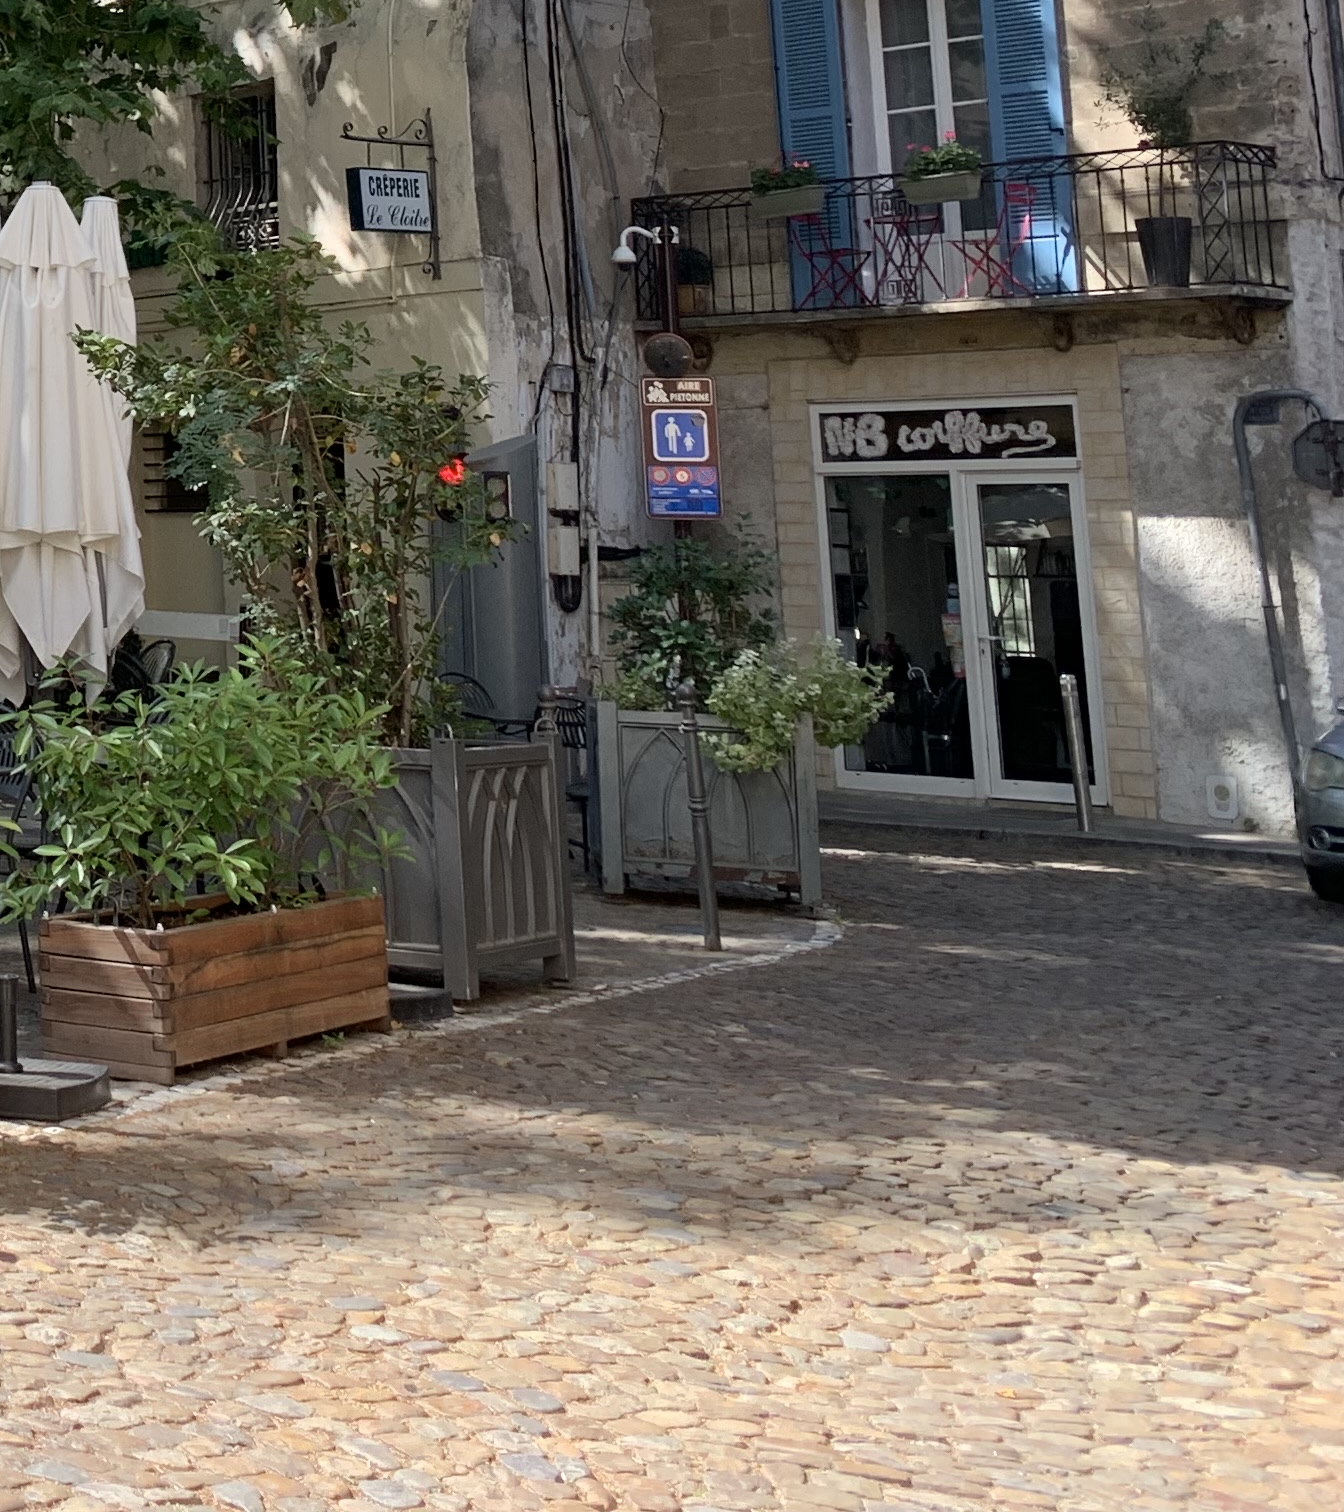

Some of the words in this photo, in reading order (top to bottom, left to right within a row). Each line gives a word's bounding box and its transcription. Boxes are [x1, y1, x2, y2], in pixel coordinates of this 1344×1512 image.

[368, 174, 421, 199] CRÊPERIE
[366, 204, 384, 226] Le
[676, 381, 701, 391] AIRE
[897, 410, 1056, 459] coiffure
